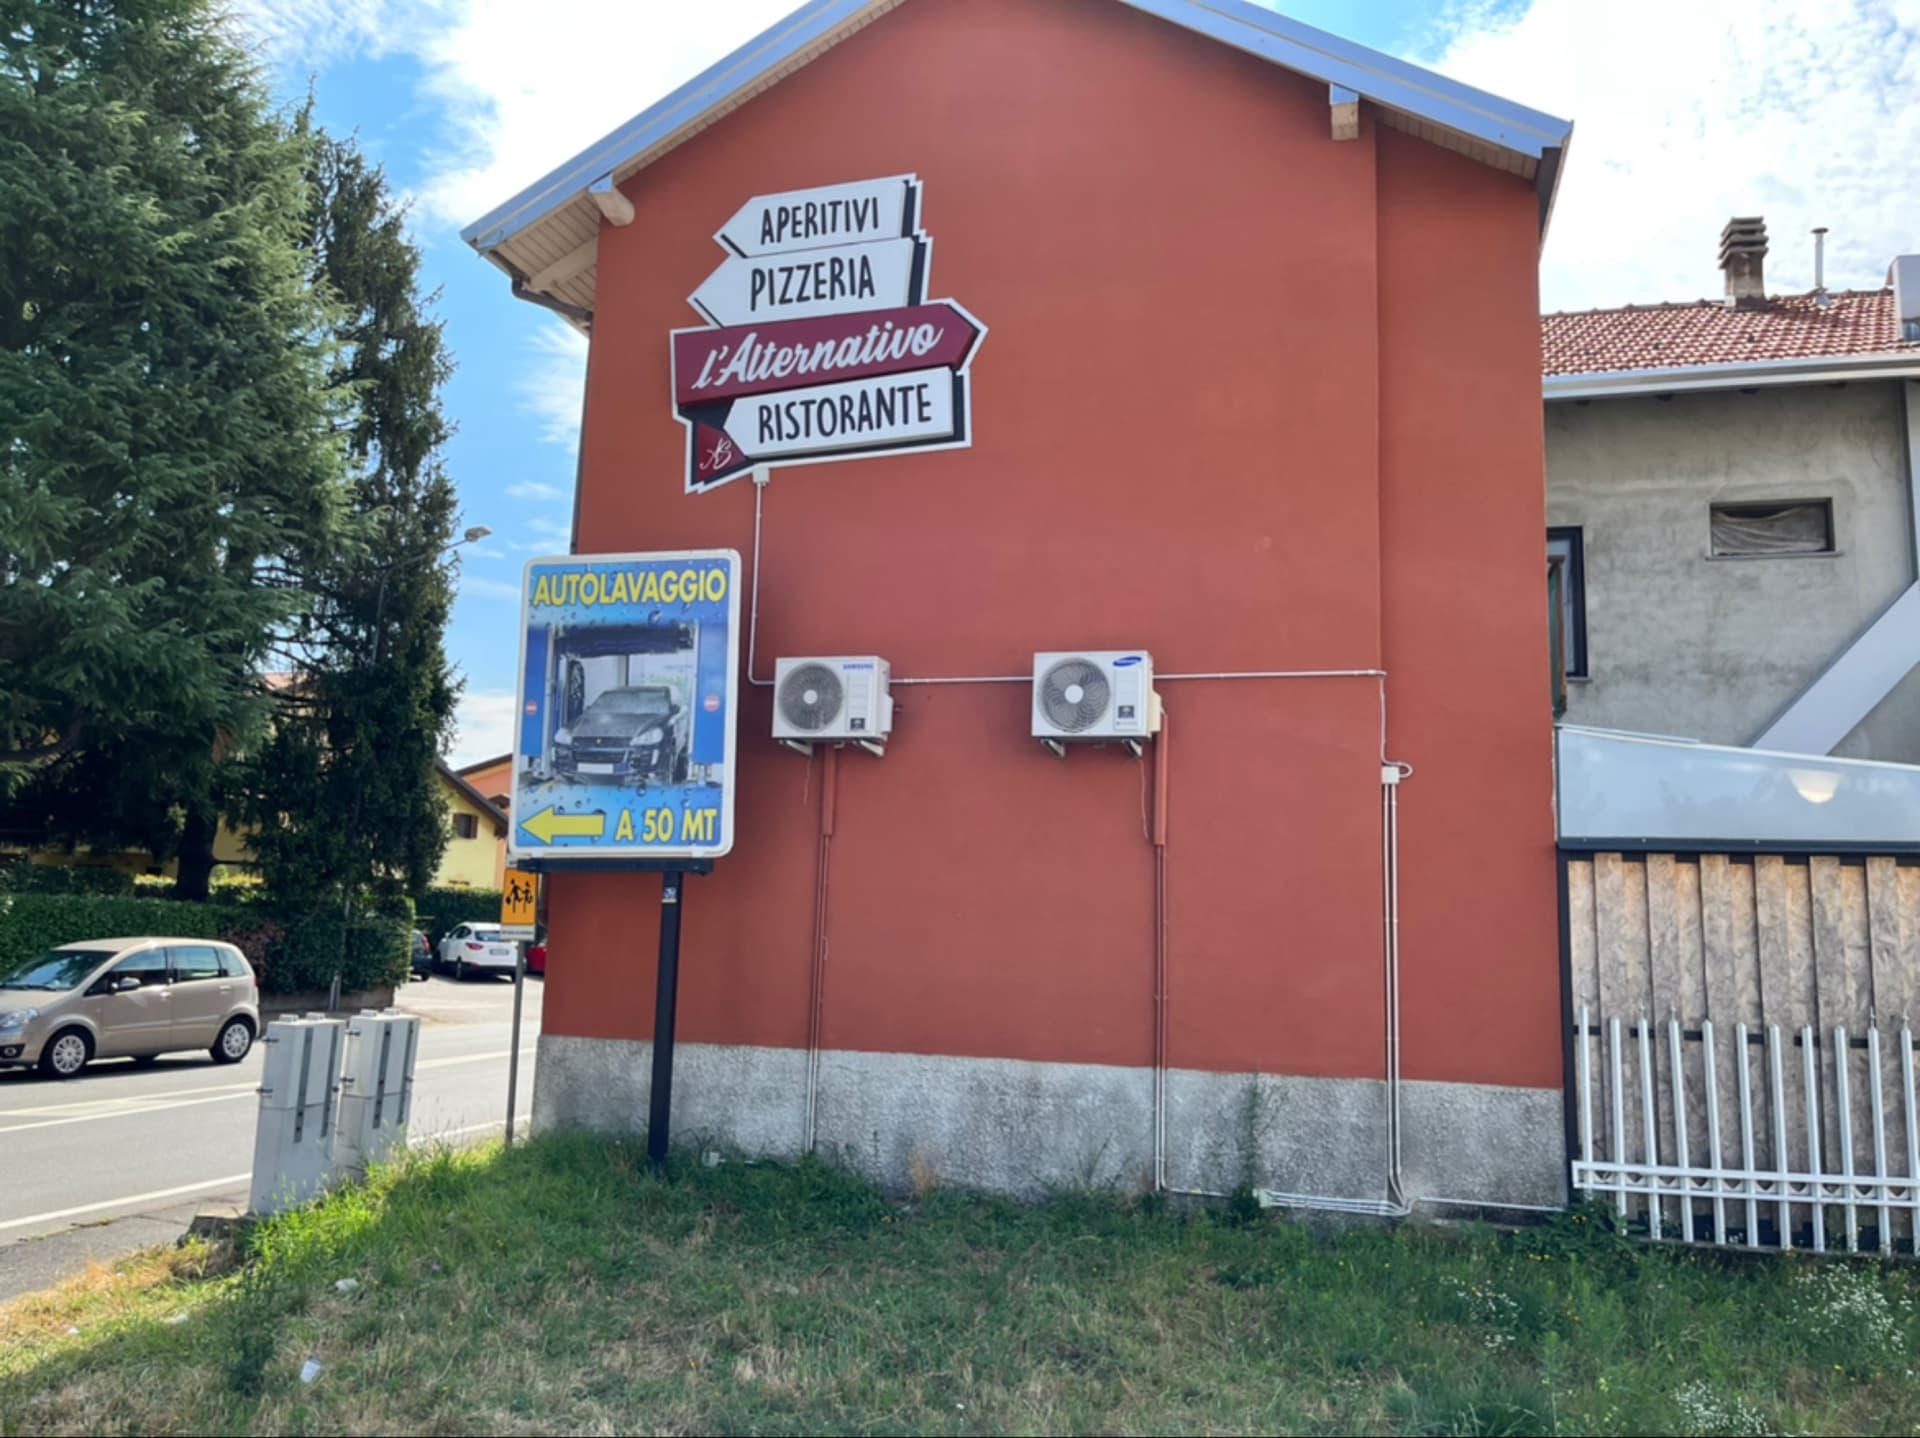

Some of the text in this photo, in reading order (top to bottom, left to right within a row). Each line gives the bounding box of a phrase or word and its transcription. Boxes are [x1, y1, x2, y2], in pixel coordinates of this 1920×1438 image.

[760, 196, 879, 246] APERITIVI
[750, 254, 876, 312] PIZZERIA
[691, 320, 945, 390] l'Alternativo
[758, 383, 932, 444] RISTORANTE
[533, 569, 727, 605] AUTOLAVAGGIO
[615, 808, 718, 843] A 50 MT
